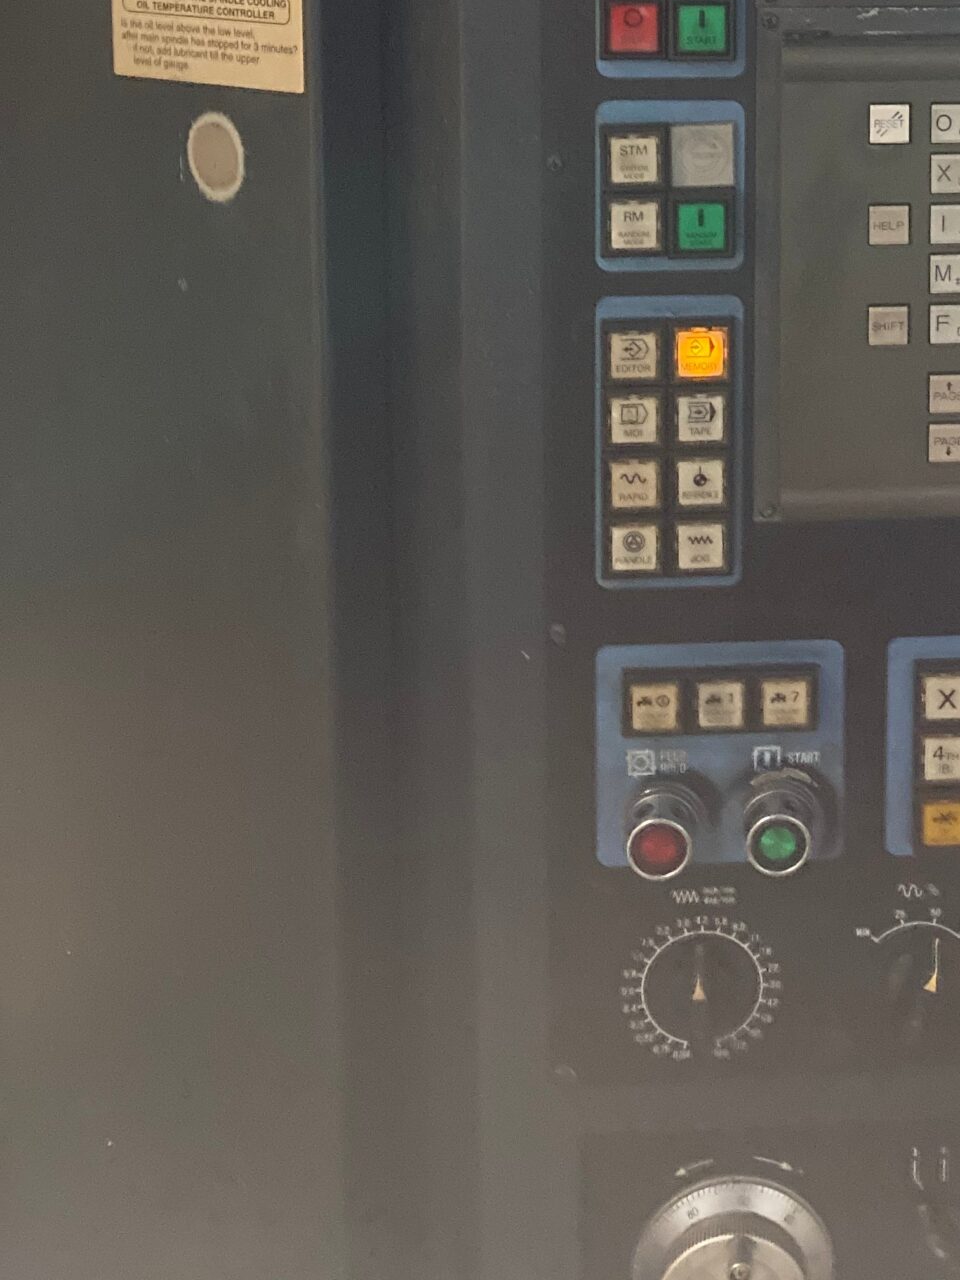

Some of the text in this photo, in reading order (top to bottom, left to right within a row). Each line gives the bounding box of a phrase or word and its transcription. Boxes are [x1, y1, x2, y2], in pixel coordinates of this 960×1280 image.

[935, 113, 953, 132] O
[619, 144, 648, 157] STM
[623, 210, 644, 222] RM
[938, 688, 957, 711] X
